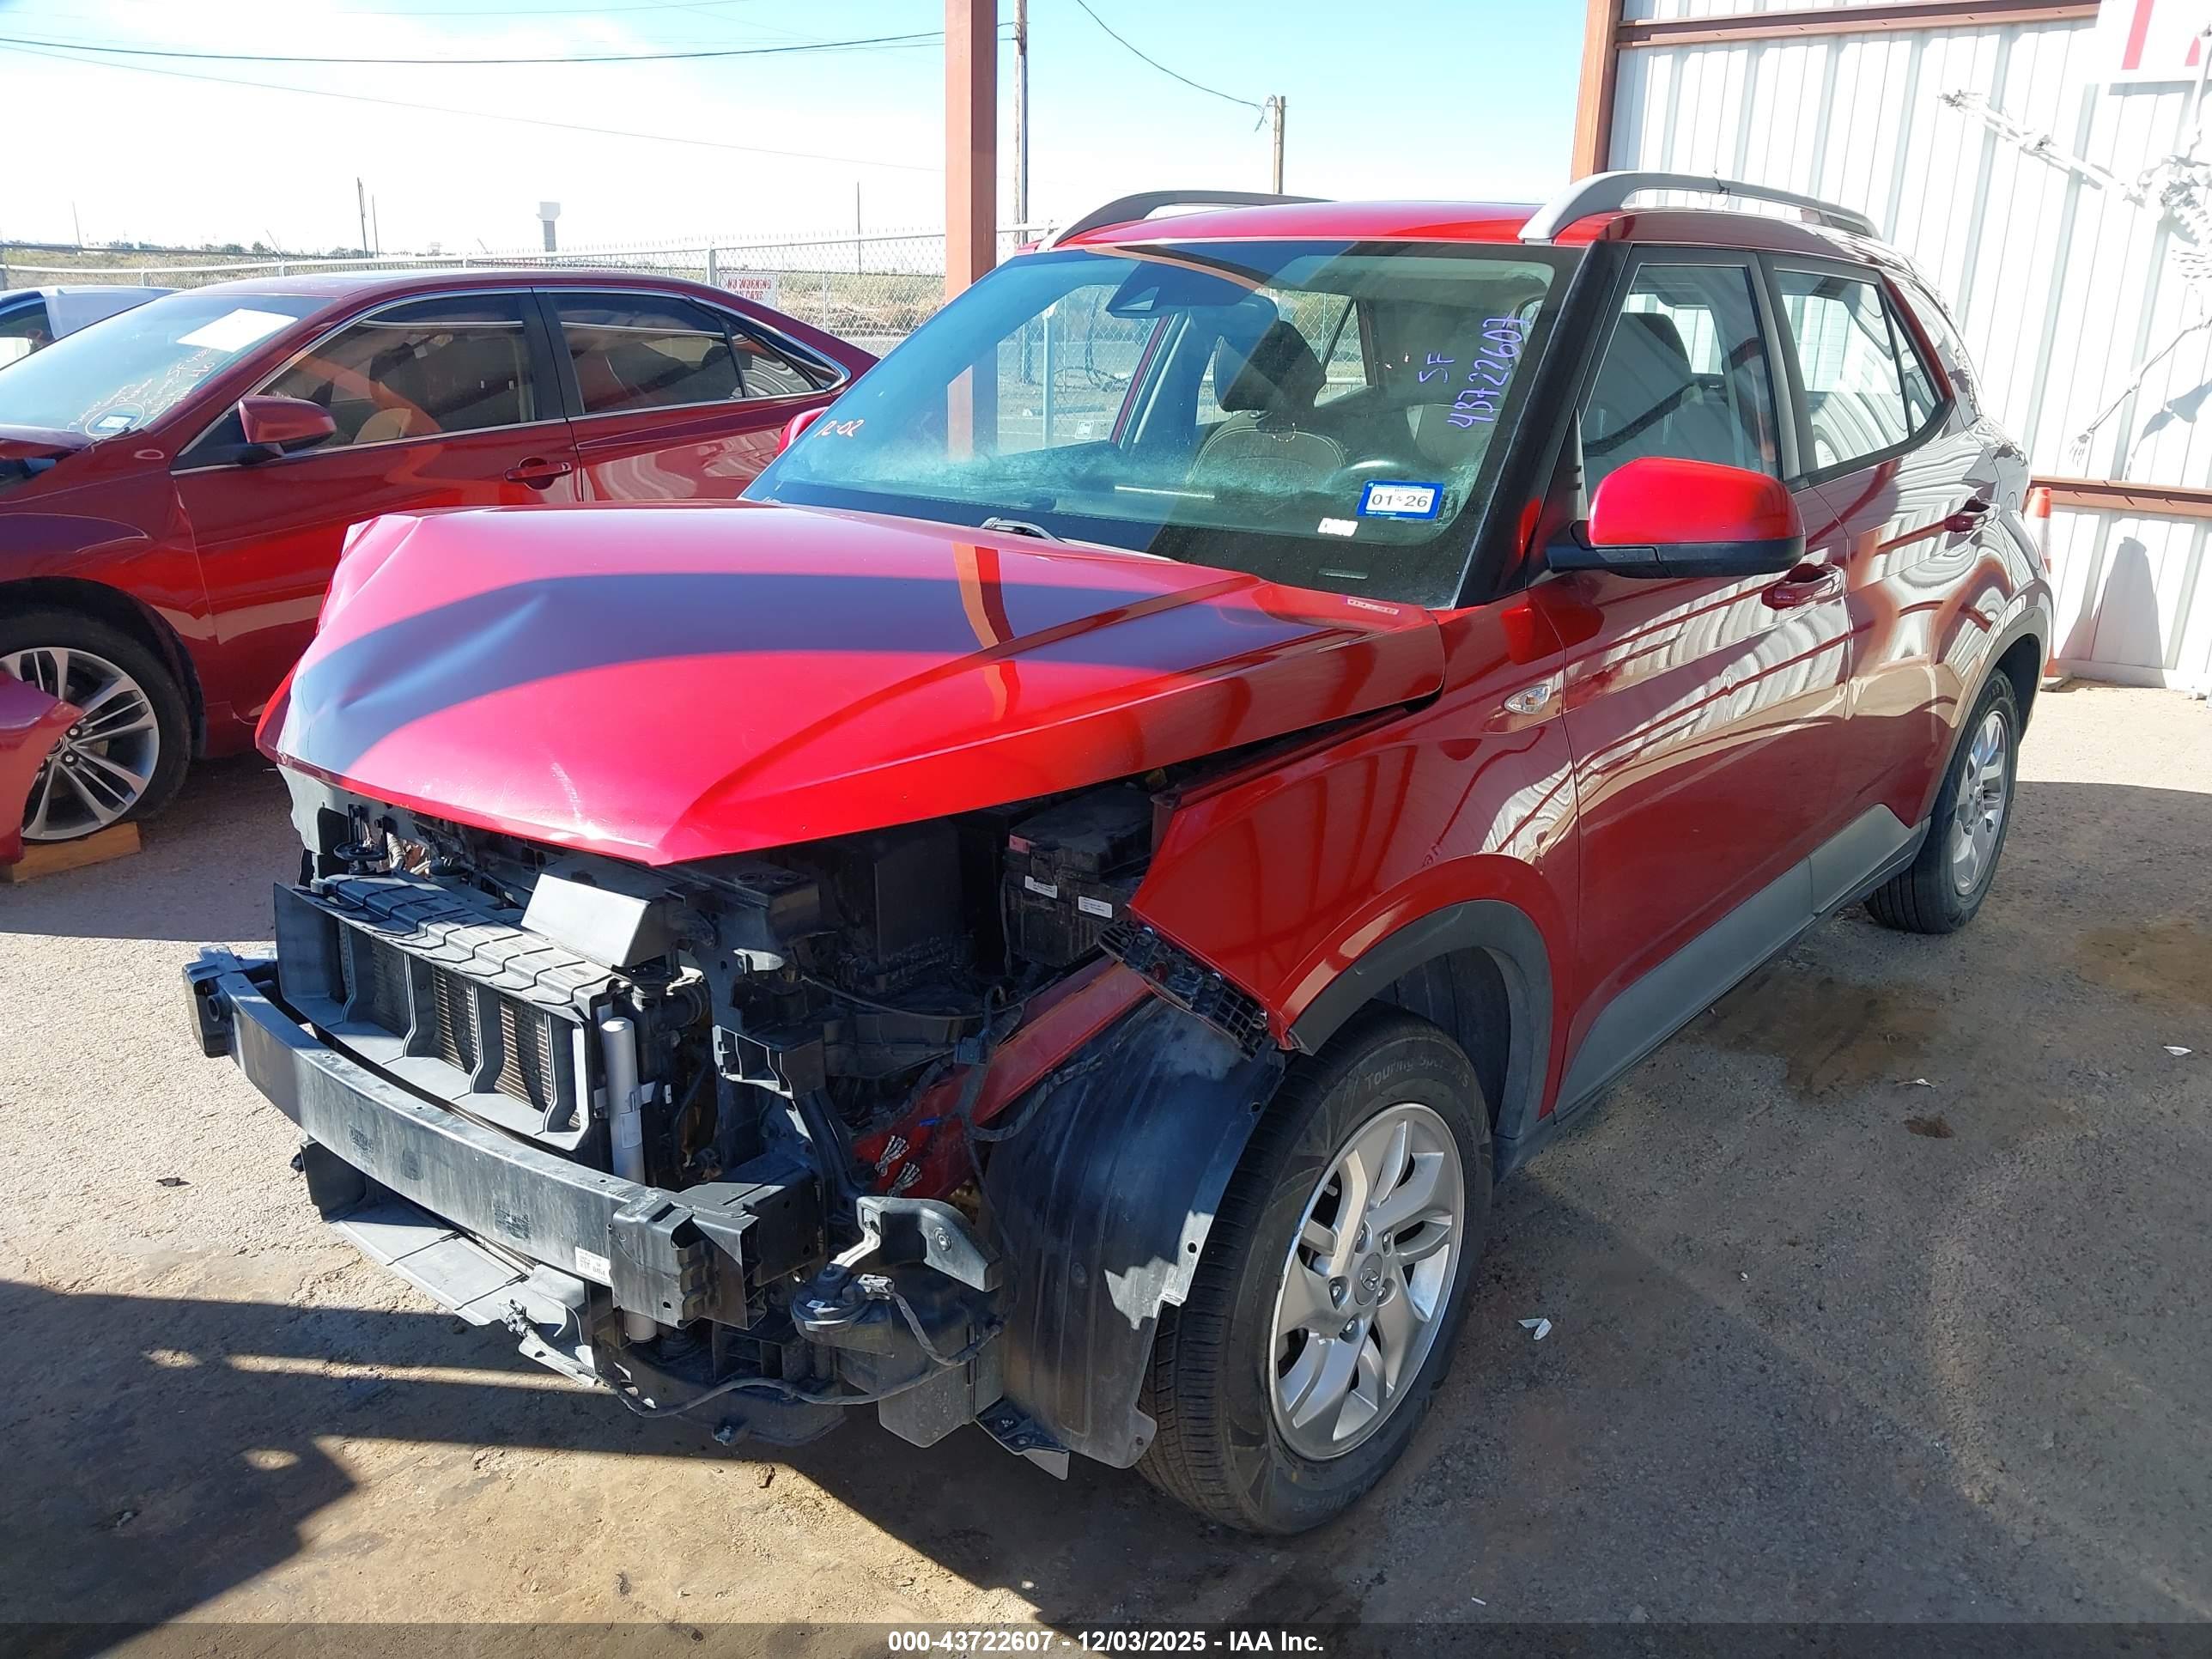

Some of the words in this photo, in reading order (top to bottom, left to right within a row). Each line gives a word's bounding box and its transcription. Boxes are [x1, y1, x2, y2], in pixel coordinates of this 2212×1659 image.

[1419, 352, 1455, 383] SF
[1447, 314, 1532, 428] 43722607
[1371, 494, 1393, 507] 01
[1404, 495, 1429, 507] 26
